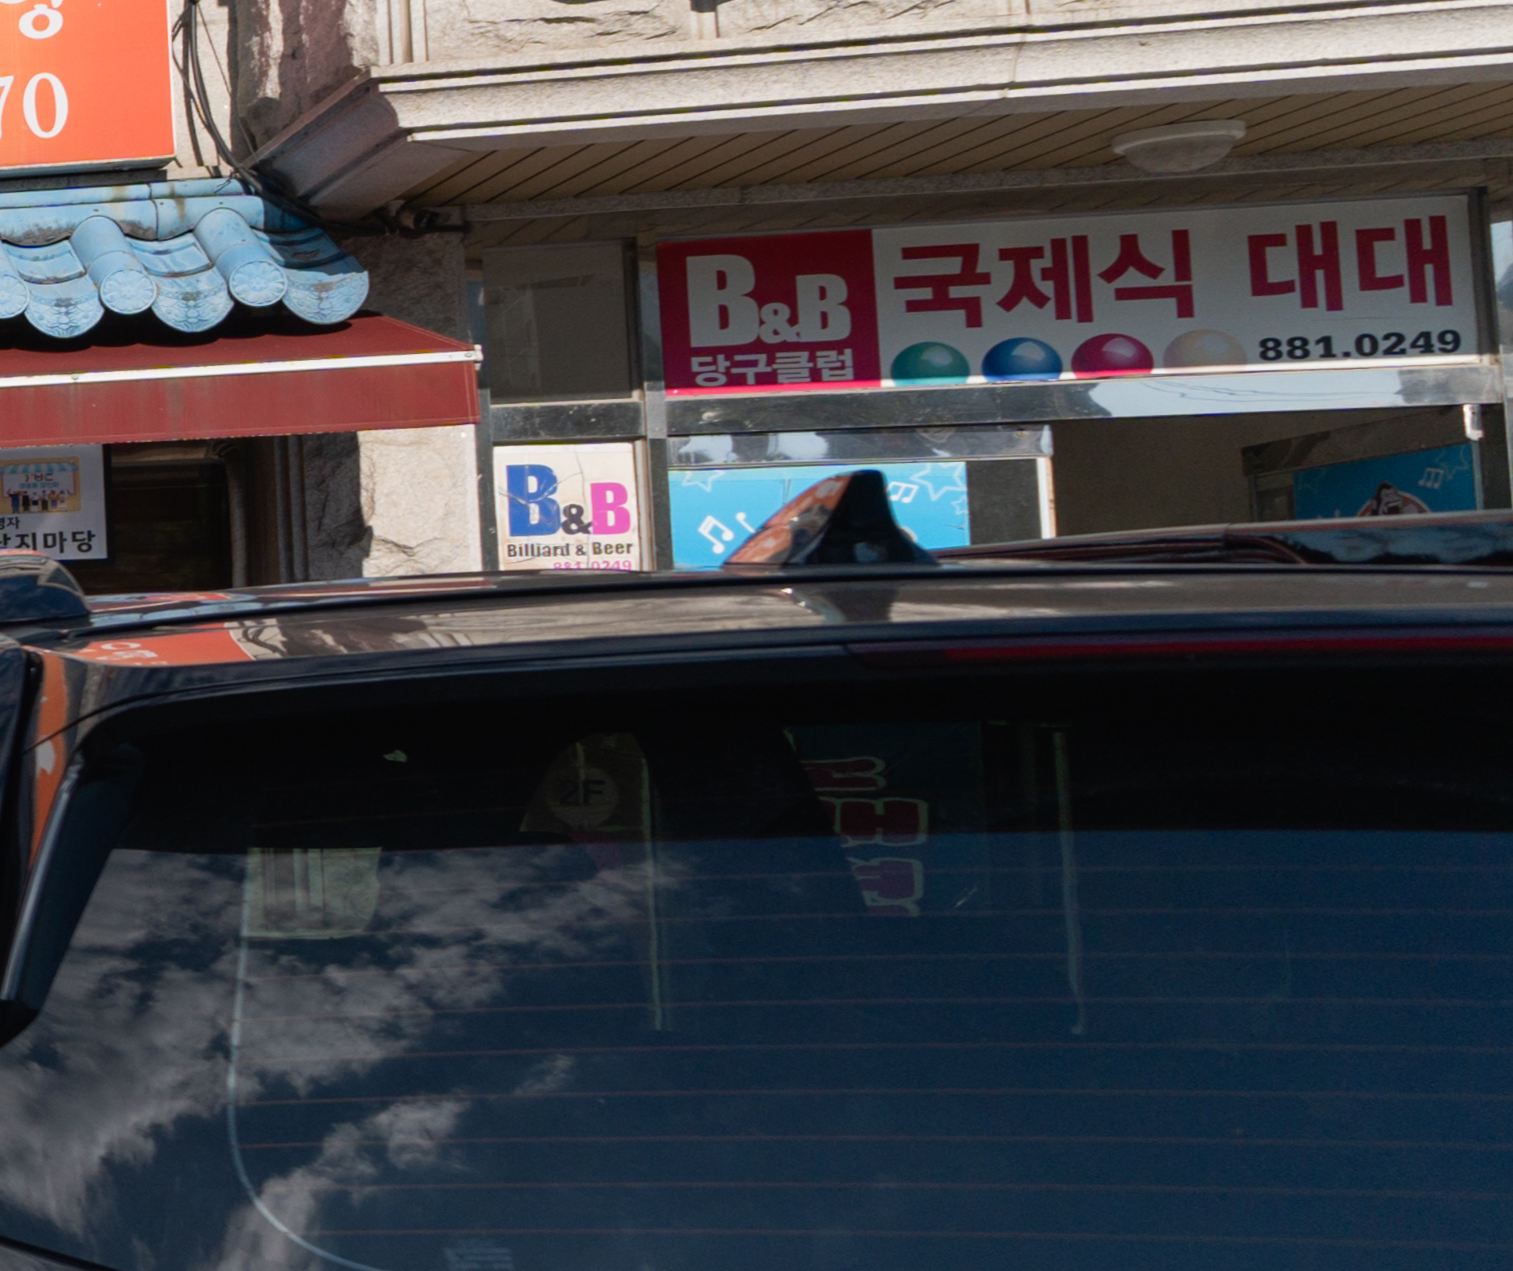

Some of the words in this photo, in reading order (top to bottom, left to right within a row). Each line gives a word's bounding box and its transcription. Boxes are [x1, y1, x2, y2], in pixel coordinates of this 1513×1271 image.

[893, 228, 1195, 328] 국제식
[1246, 215, 1454, 312] 대대
[686, 253, 851, 348] B&B
[691, 348, 855, 387] 당구클럽
[1259, 329, 1461, 361] 881.0249
[506, 464, 631, 537] B&B
[507, 543, 570, 557] Billiard
[575, 543, 587, 556] &
[592, 542, 633, 556] Beer
